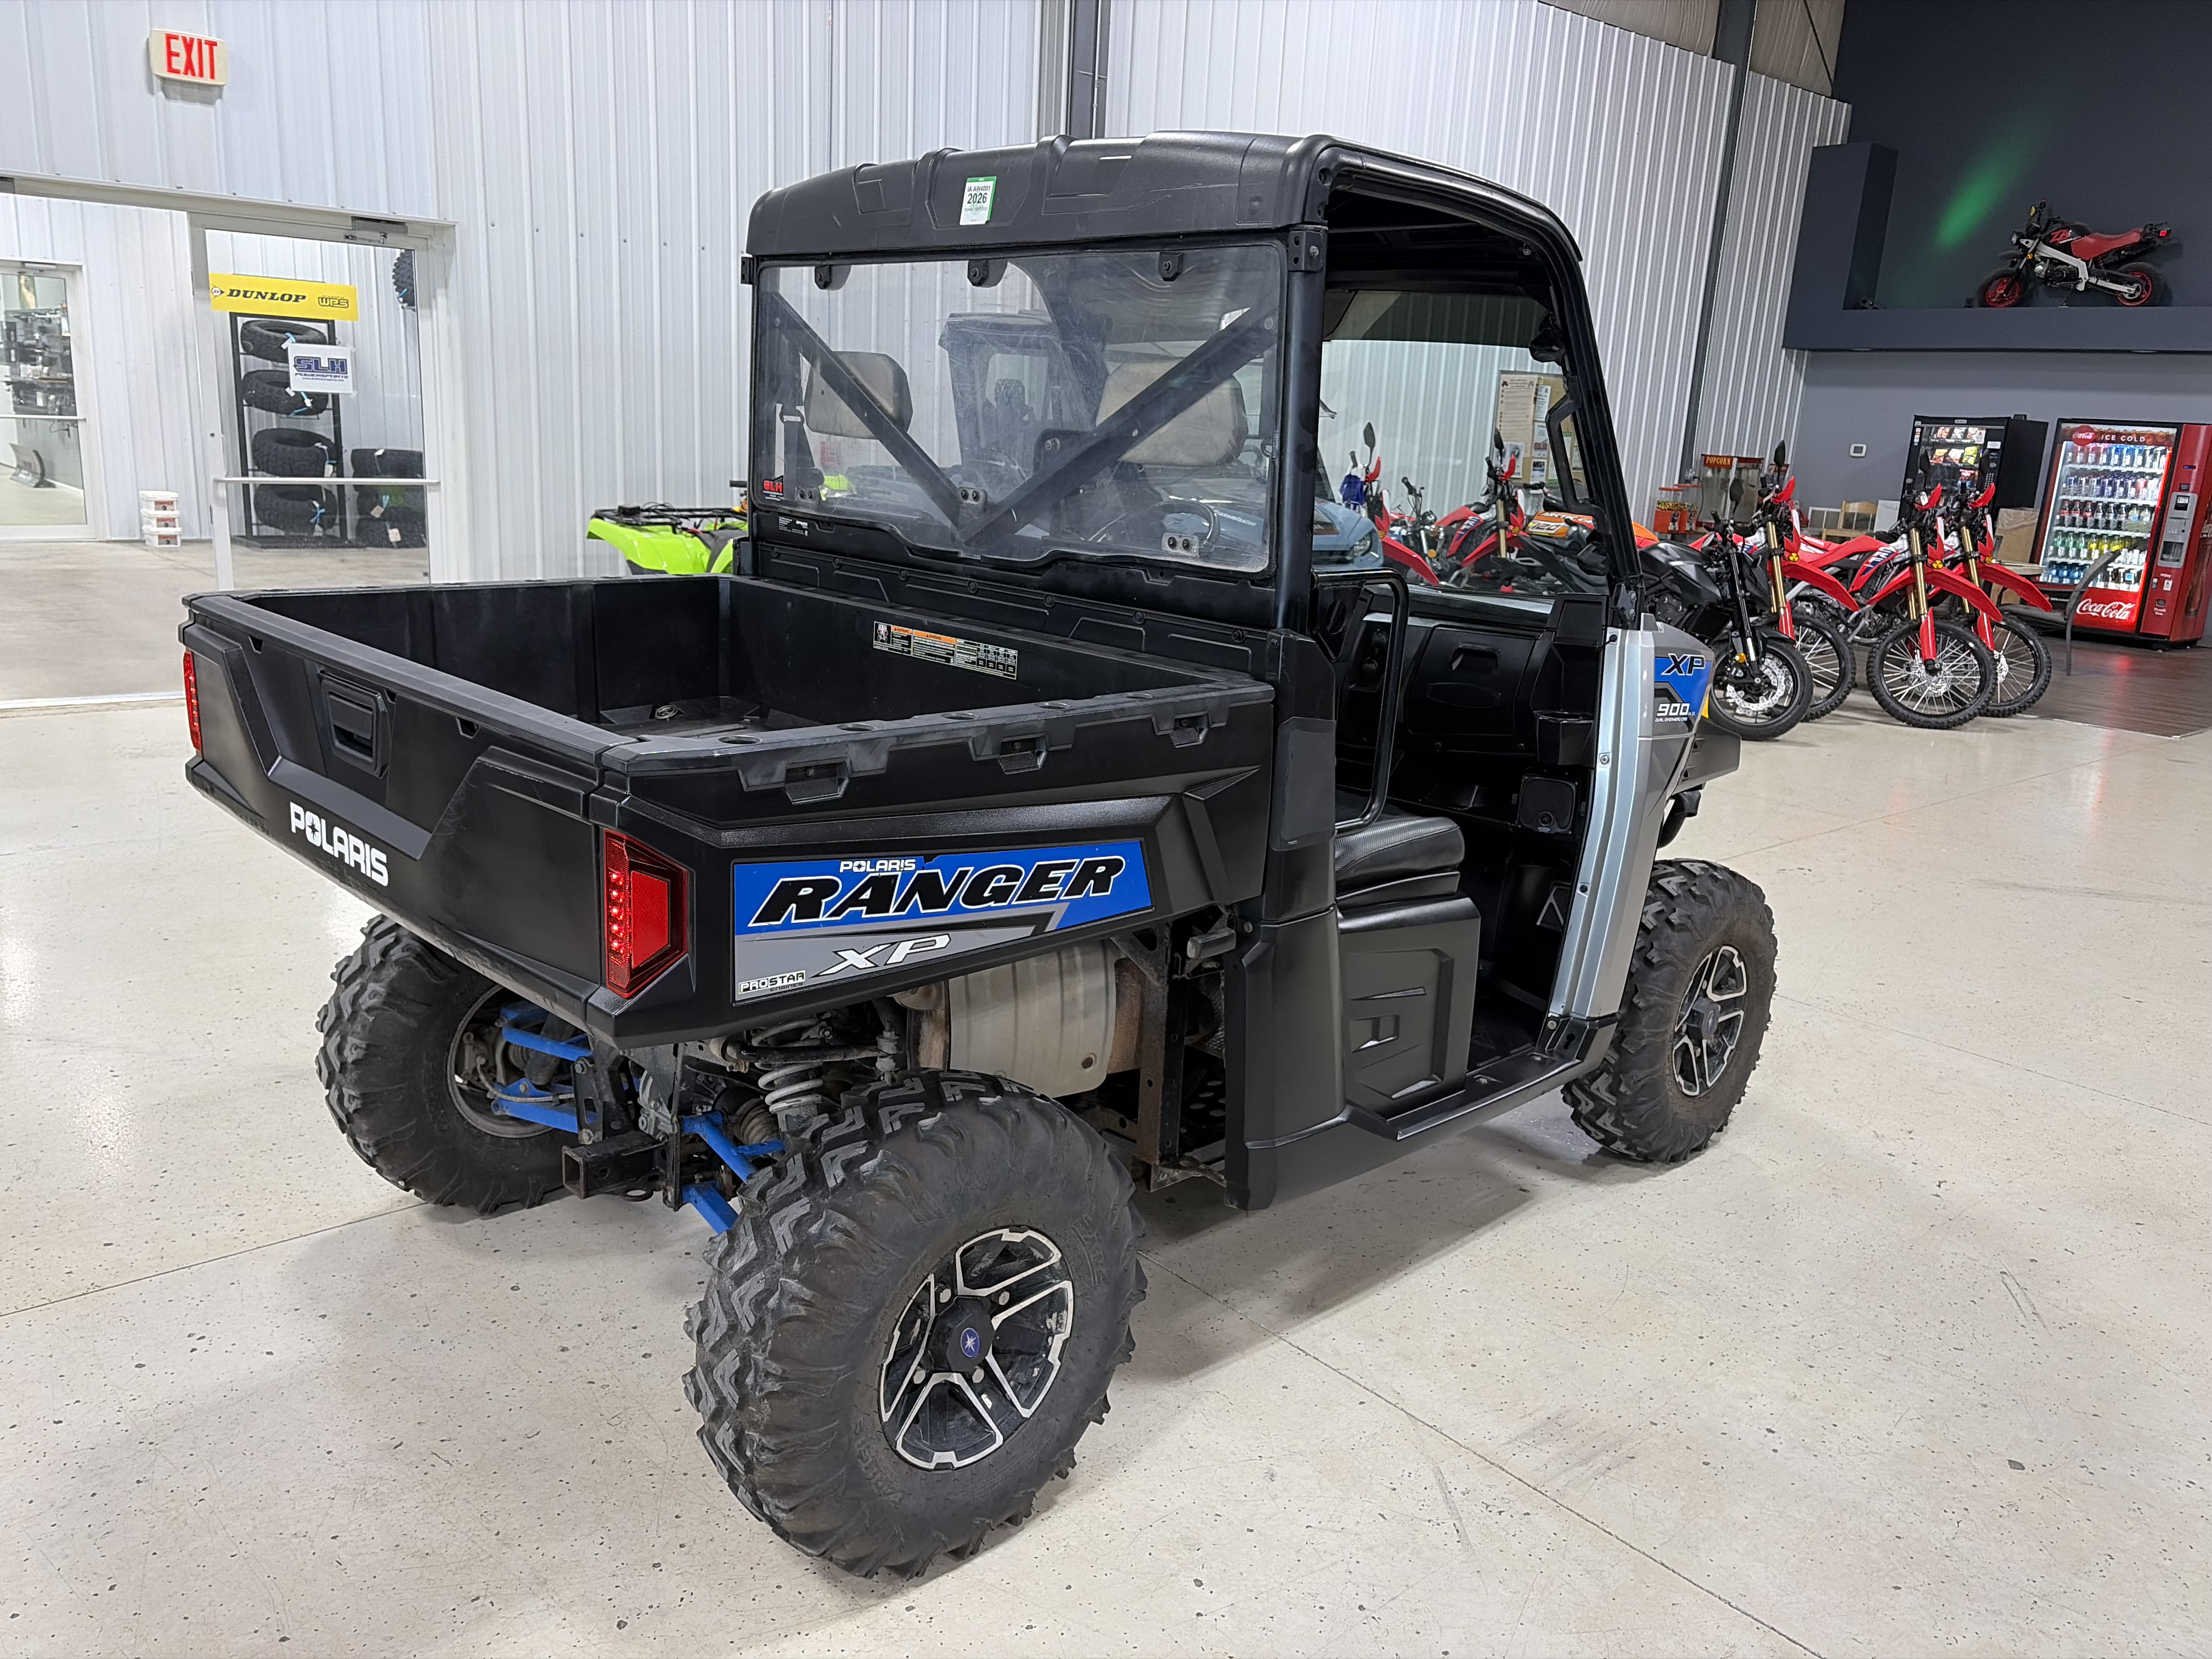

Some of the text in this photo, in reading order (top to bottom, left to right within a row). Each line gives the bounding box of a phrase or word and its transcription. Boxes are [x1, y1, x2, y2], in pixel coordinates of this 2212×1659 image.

[165, 33, 217, 80] EXIT
[967, 192, 988, 204] 2026
[227, 289, 349, 308] DUNLOP WPS
[294, 356, 347, 374] SLH
[1706, 456, 1731, 465] POPCORN
[764, 480, 783, 492] SLH
[2076, 599, 2135, 620] Coca-Cola
[1661, 653, 1706, 676] XP
[1657, 703, 1690, 716] 900
[290, 802, 388, 887] POLARIS
[839, 858, 916, 873] POLARIS
[748, 856, 1125, 927] RANGER
[810, 934, 952, 978] XP
[740, 972, 805, 992] PROSTAR
